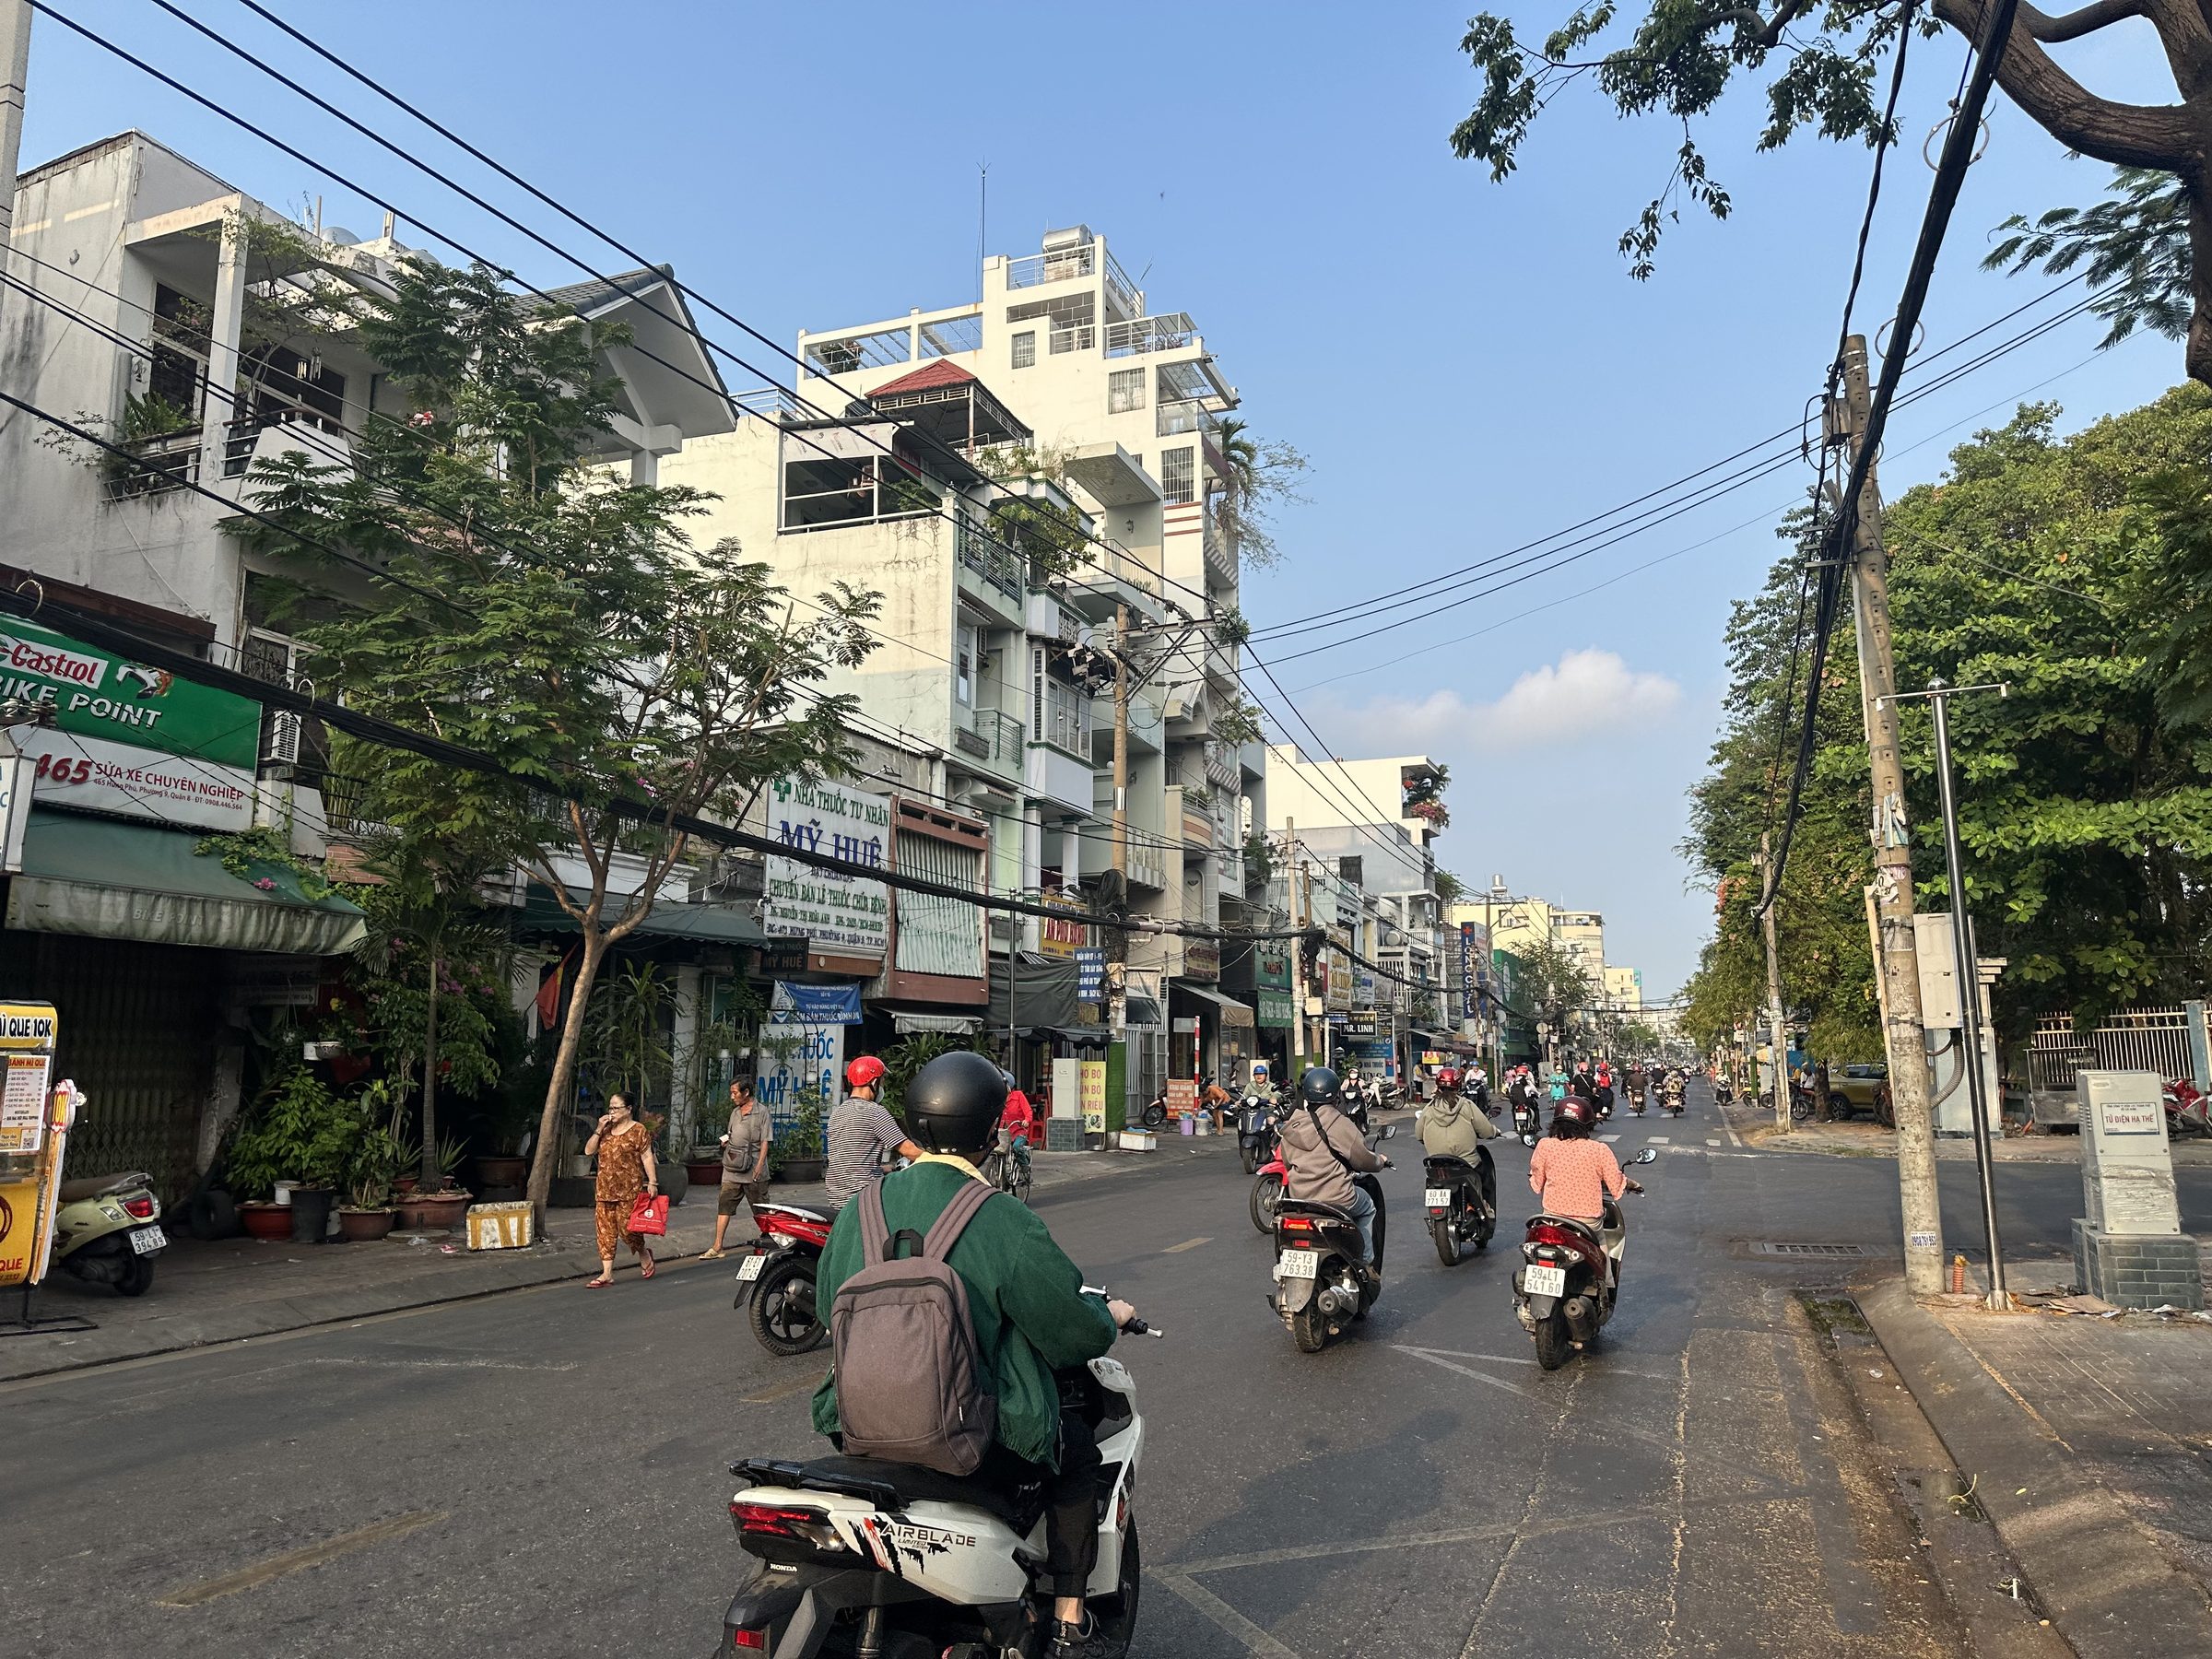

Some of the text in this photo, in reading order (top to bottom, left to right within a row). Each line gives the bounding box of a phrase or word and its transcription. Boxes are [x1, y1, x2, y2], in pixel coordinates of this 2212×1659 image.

[11, 643, 100, 684] Castrol
[67, 692, 162, 729] POINT
[37, 753, 92, 784] 465
[93, 778, 106, 786] 465
[95, 760, 244, 803] SỬA XE CHUYÊN NGHIỆP
[816, 788, 847, 816] THUỐC
[849, 799, 864, 819] TƯ
[865, 804, 889, 828] NHÂN
[780, 818, 823, 853] MỸ
[800, 881, 816, 903] BÁN
[828, 885, 850, 909] THUỐC
[0, 1014, 52, 1037] Ì QUE 10K
[1358, 1024, 1373, 1032] LINH
[2114, 1113, 2130, 1124] ĐIỆN
[1283, 1263, 1313, 1276] 763.38
[1288, 1252, 1312, 1264] 59-Y3
[1526, 1279, 1561, 1294] 541.60
[882, 1524, 977, 1547] AIRBLADE
[770, 1563, 798, 1572] HONDA
